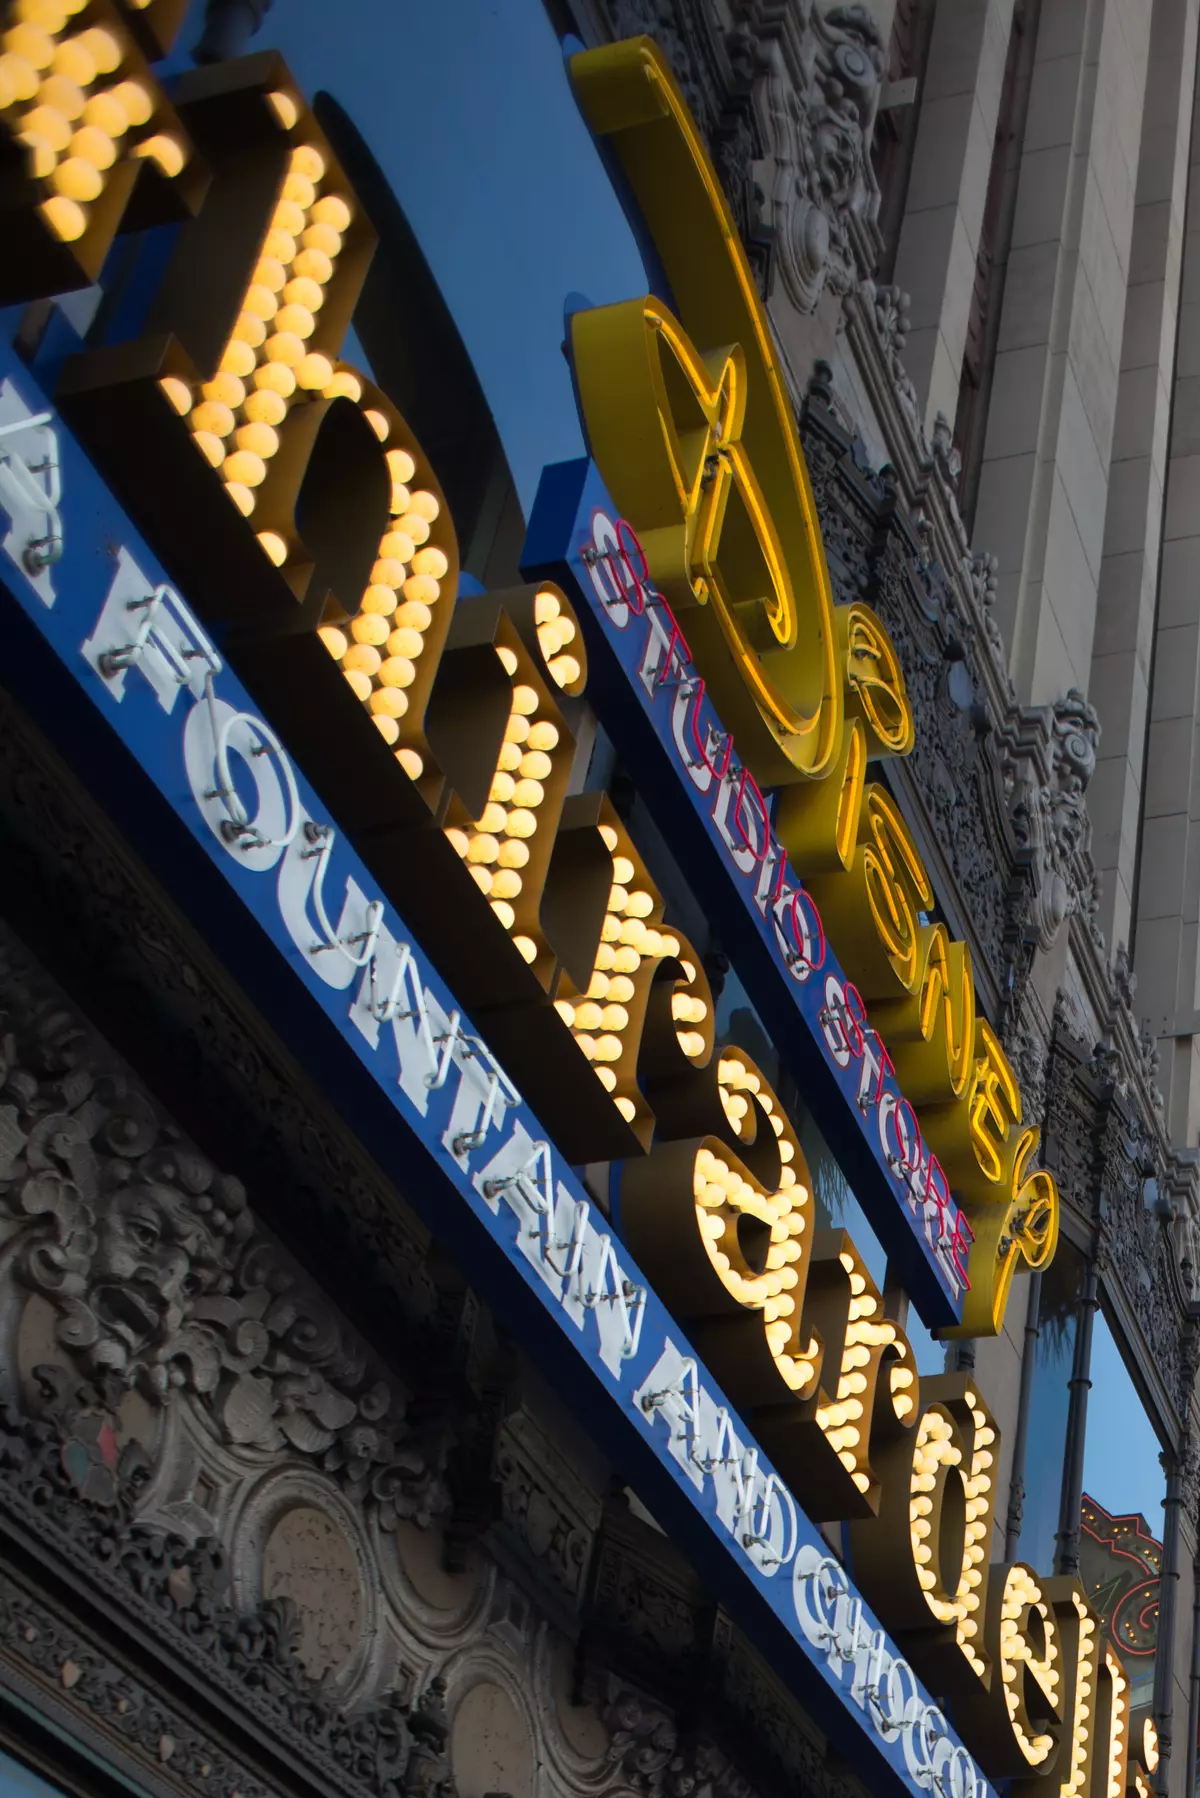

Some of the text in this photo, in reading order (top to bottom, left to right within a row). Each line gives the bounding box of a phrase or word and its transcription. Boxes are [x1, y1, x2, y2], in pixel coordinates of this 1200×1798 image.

[80, 545, 646, 1380] FOUNTAIN
[633, 1336, 797, 1577] AND
[579, 510, 974, 1292] STUDIO STORE
